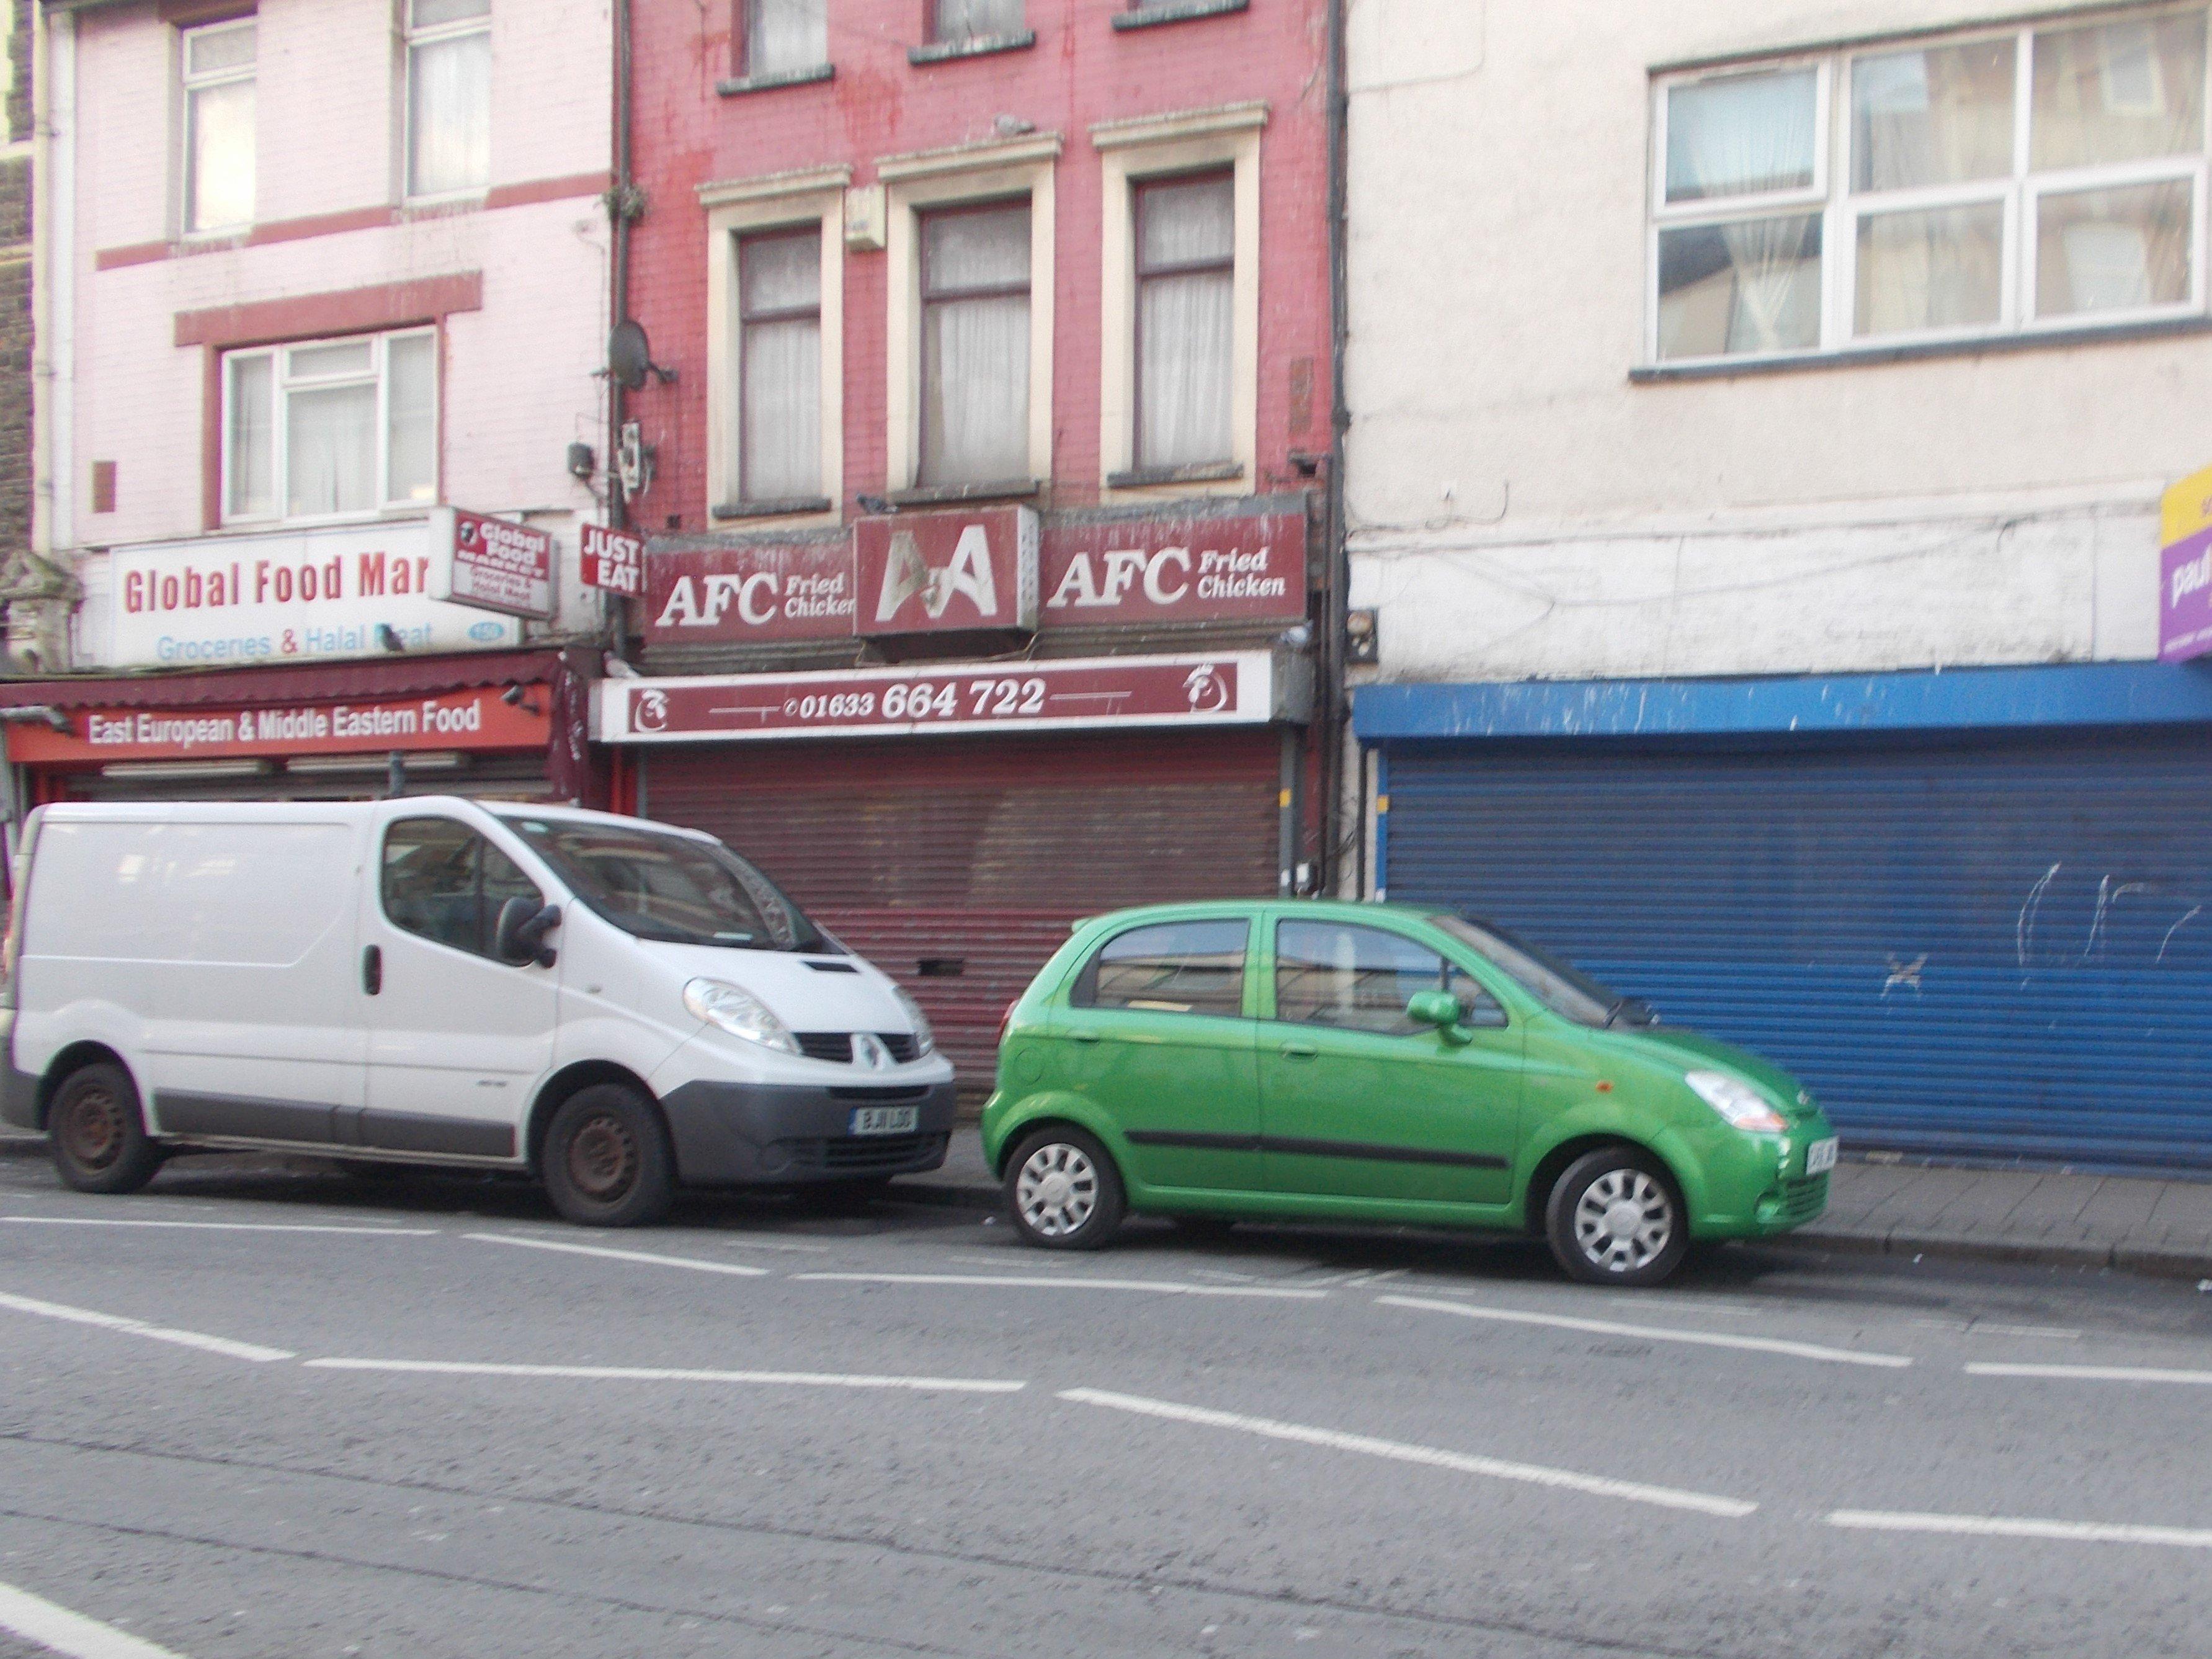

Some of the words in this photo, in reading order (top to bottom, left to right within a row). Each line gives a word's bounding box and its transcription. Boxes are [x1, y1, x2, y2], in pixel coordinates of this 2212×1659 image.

[479, 522, 545, 552] Global
[486, 540, 536, 565] Food
[584, 529, 640, 565] JUST
[125, 561, 240, 613] Global
[256, 554, 342, 602] Food
[597, 558, 640, 592] EAT
[1046, 546, 1192, 608] AFC
[1198, 546, 1269, 574] Fried
[1197, 571, 1285, 599] Chicken
[654, 571, 778, 627] AFC
[784, 571, 844, 596] Fried
[158, 635, 272, 660] Groceries
[282, 629, 298, 653] &
[305, 624, 365, 652] Halal
[799, 692, 876, 718] 01633
[881, 682, 959, 718] 664
[968, 677, 1046, 714] 722
[89, 714, 133, 743] East
[137, 713, 234, 749] European
[238, 711, 255, 741] &
[258, 707, 328, 740] Middle
[333, 705, 416, 736] Eastern
[422, 698, 481, 733] Food
